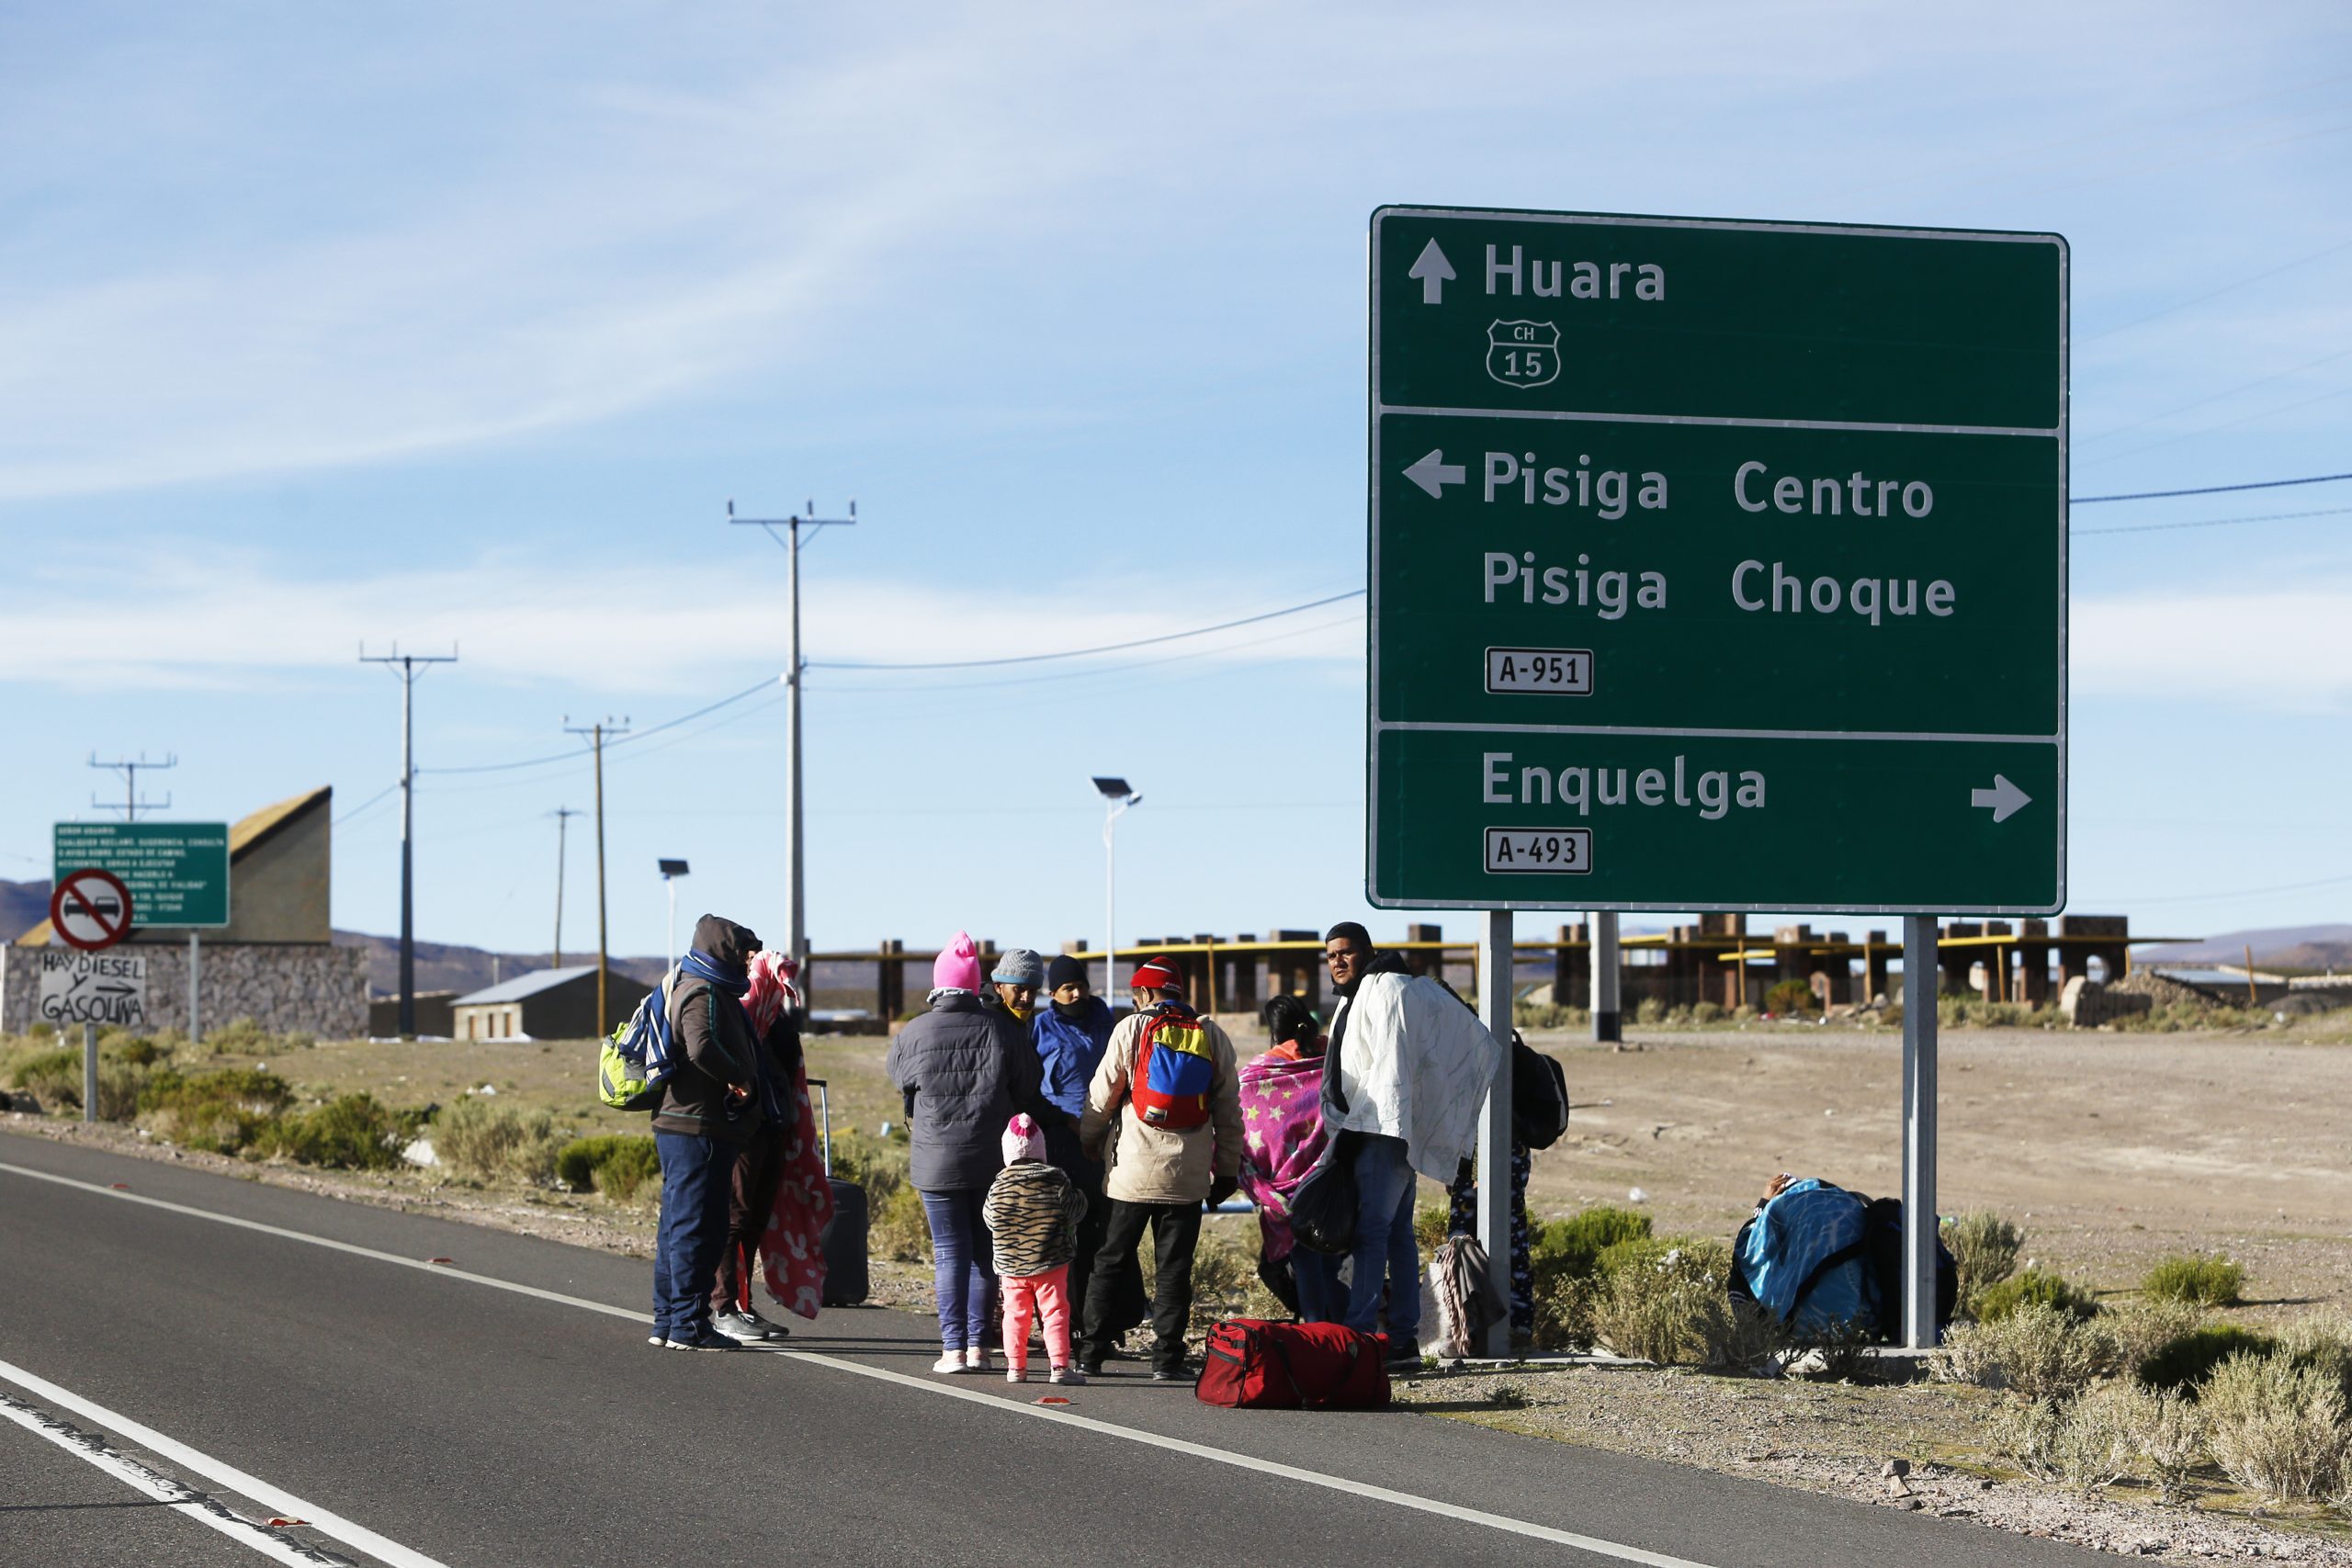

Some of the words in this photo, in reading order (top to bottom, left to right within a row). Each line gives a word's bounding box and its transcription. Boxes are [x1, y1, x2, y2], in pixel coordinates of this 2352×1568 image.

[1486, 244, 1666, 301] Huara
[1513, 326, 1535, 342] CH
[1504, 351, 1543, 378] 15
[1484, 451, 1668, 520] Pisiga
[1734, 460, 1934, 518] Centro
[1484, 551, 1668, 620] Pisiga
[1732, 559, 1956, 626] Choque
[1498, 656, 1580, 685] A-951
[1482, 751, 1767, 820] Enquelga
[146, 849, 155, 857] DE
[1497, 837, 1578, 865] A-493
[43, 953, 75, 972] HAY
[66, 973, 89, 995] Y
[42, 993, 144, 1025] GASOLINA
